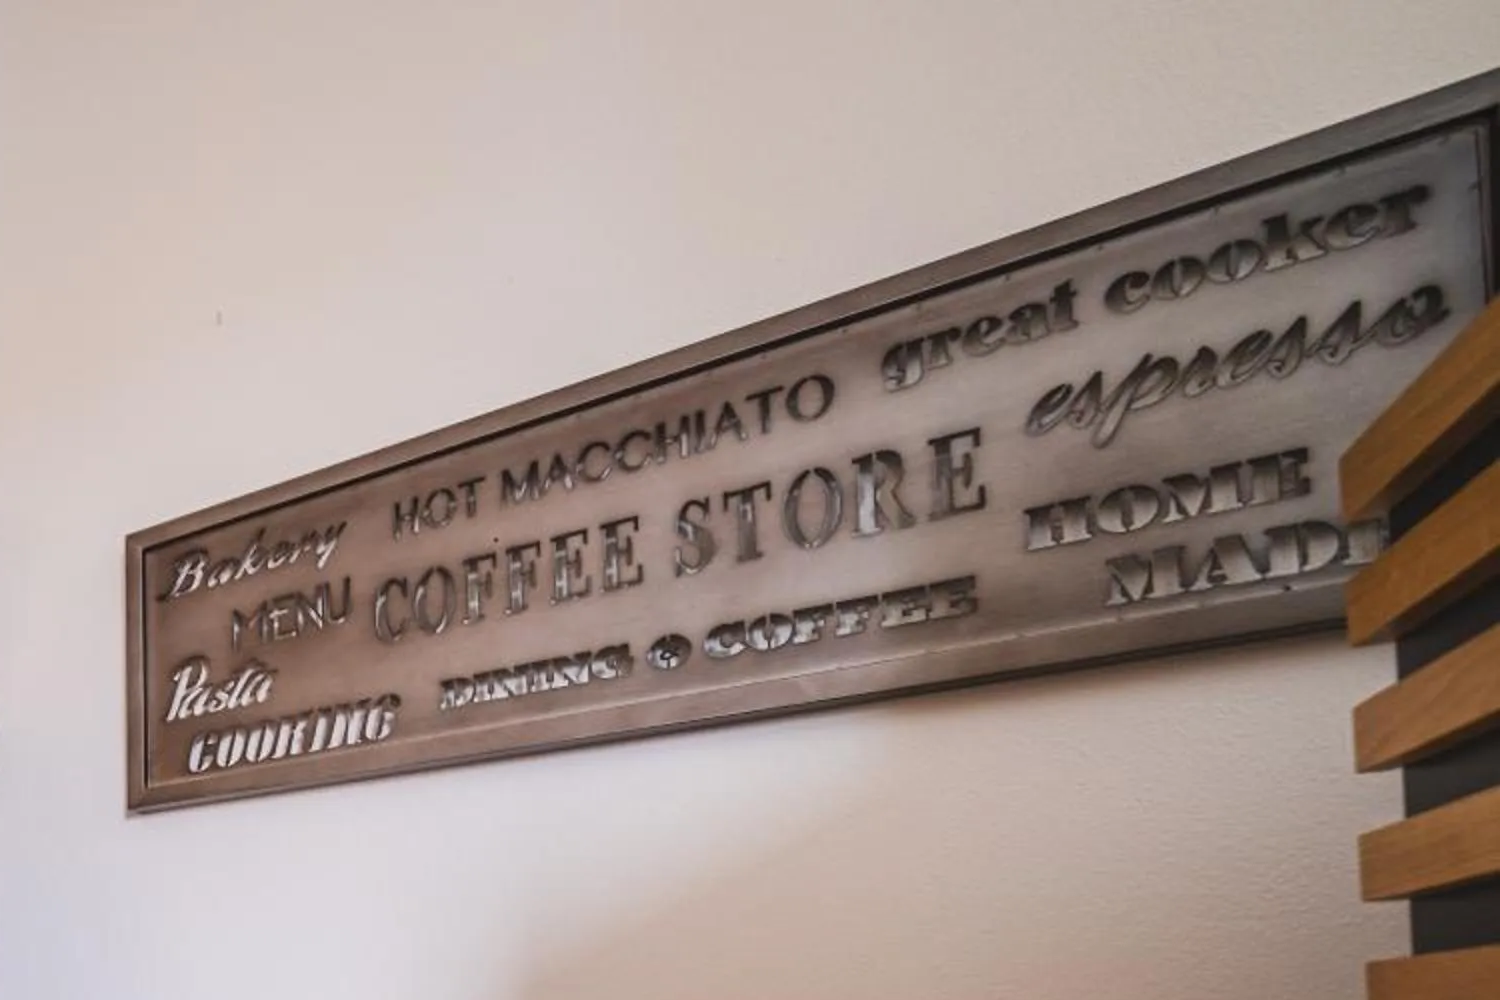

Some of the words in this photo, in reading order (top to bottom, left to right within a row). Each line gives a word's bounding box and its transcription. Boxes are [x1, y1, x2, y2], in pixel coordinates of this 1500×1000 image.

[881, 277, 1081, 394] great
[1103, 184, 1432, 315] cooker
[1024, 283, 1452, 450] espresso
[392, 475, 486, 541] HOT
[500, 374, 834, 505] MACCHIATO
[1024, 446, 1314, 552] HOME
[160, 517, 350, 600] Bakery
[374, 514, 643, 646] COFFEE
[673, 427, 988, 578] STORE
[230, 575, 353, 652] MENU
[438, 636, 634, 712] DINING
[703, 574, 980, 660] COFFEE
[166, 653, 280, 725] Pasta
[187, 693, 403, 777] COOKING
